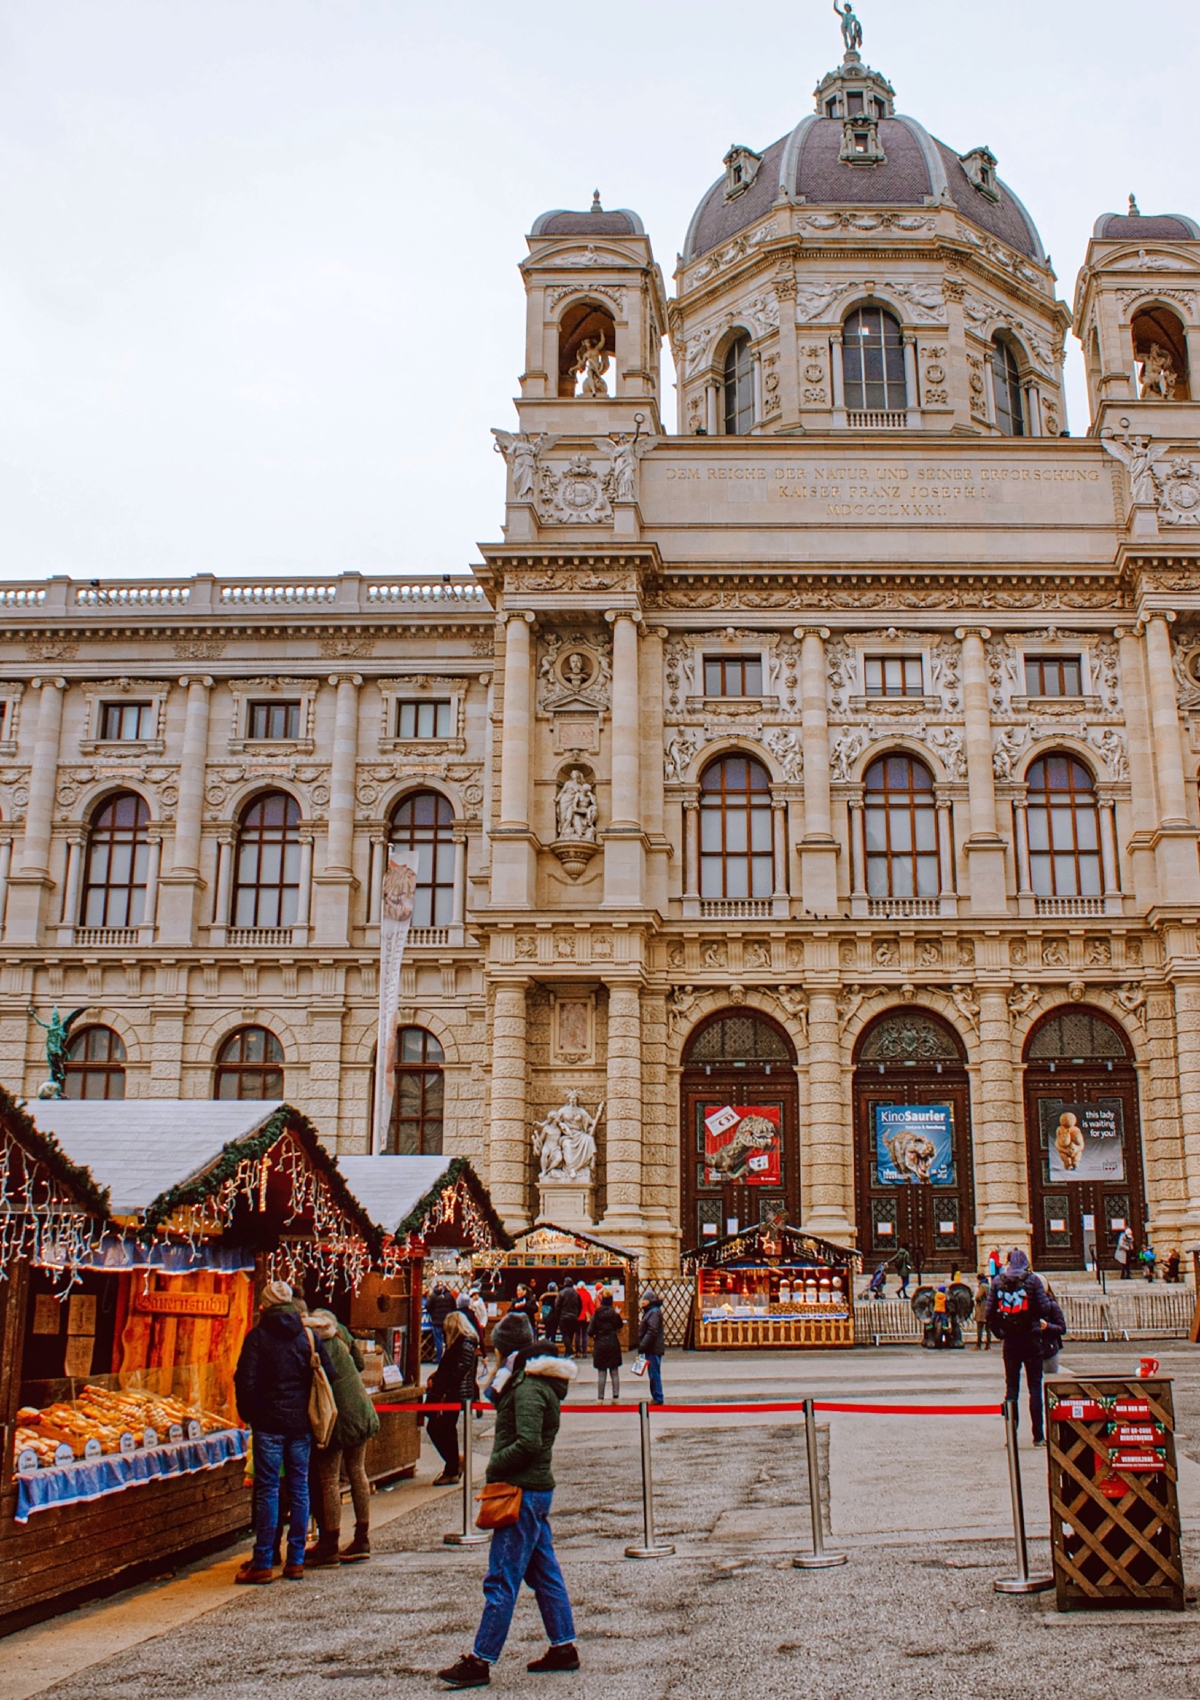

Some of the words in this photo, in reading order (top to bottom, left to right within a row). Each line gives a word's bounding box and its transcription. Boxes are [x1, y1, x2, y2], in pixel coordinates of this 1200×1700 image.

[666, 468, 701, 480] DEM
[707, 468, 766, 480] REICHE
[775, 468, 807, 480] DER
[814, 468, 870, 480] NATUR
[876, 468, 909, 480] UND
[917, 468, 973, 481] SEINER
[981, 469, 1100, 481] ERFORSCHUNG
[779, 486, 841, 498] KAISER
[849, 486, 900, 498] FRANZ
[910, 487, 975, 499] JOSEPH
[827, 504, 947, 516] MDCCCLXXXI.
[881, 1110, 946, 1122] KinoSaurier
[1085, 1111, 1099, 1119] this
[1100, 1110, 1115, 1120] lady
[1082, 1120, 1088, 1128] is
[1089, 1120, 1116, 1129] waiting
[1090, 1129, 1100, 1137] for
[1100, 1129, 1116, 1139] you!
